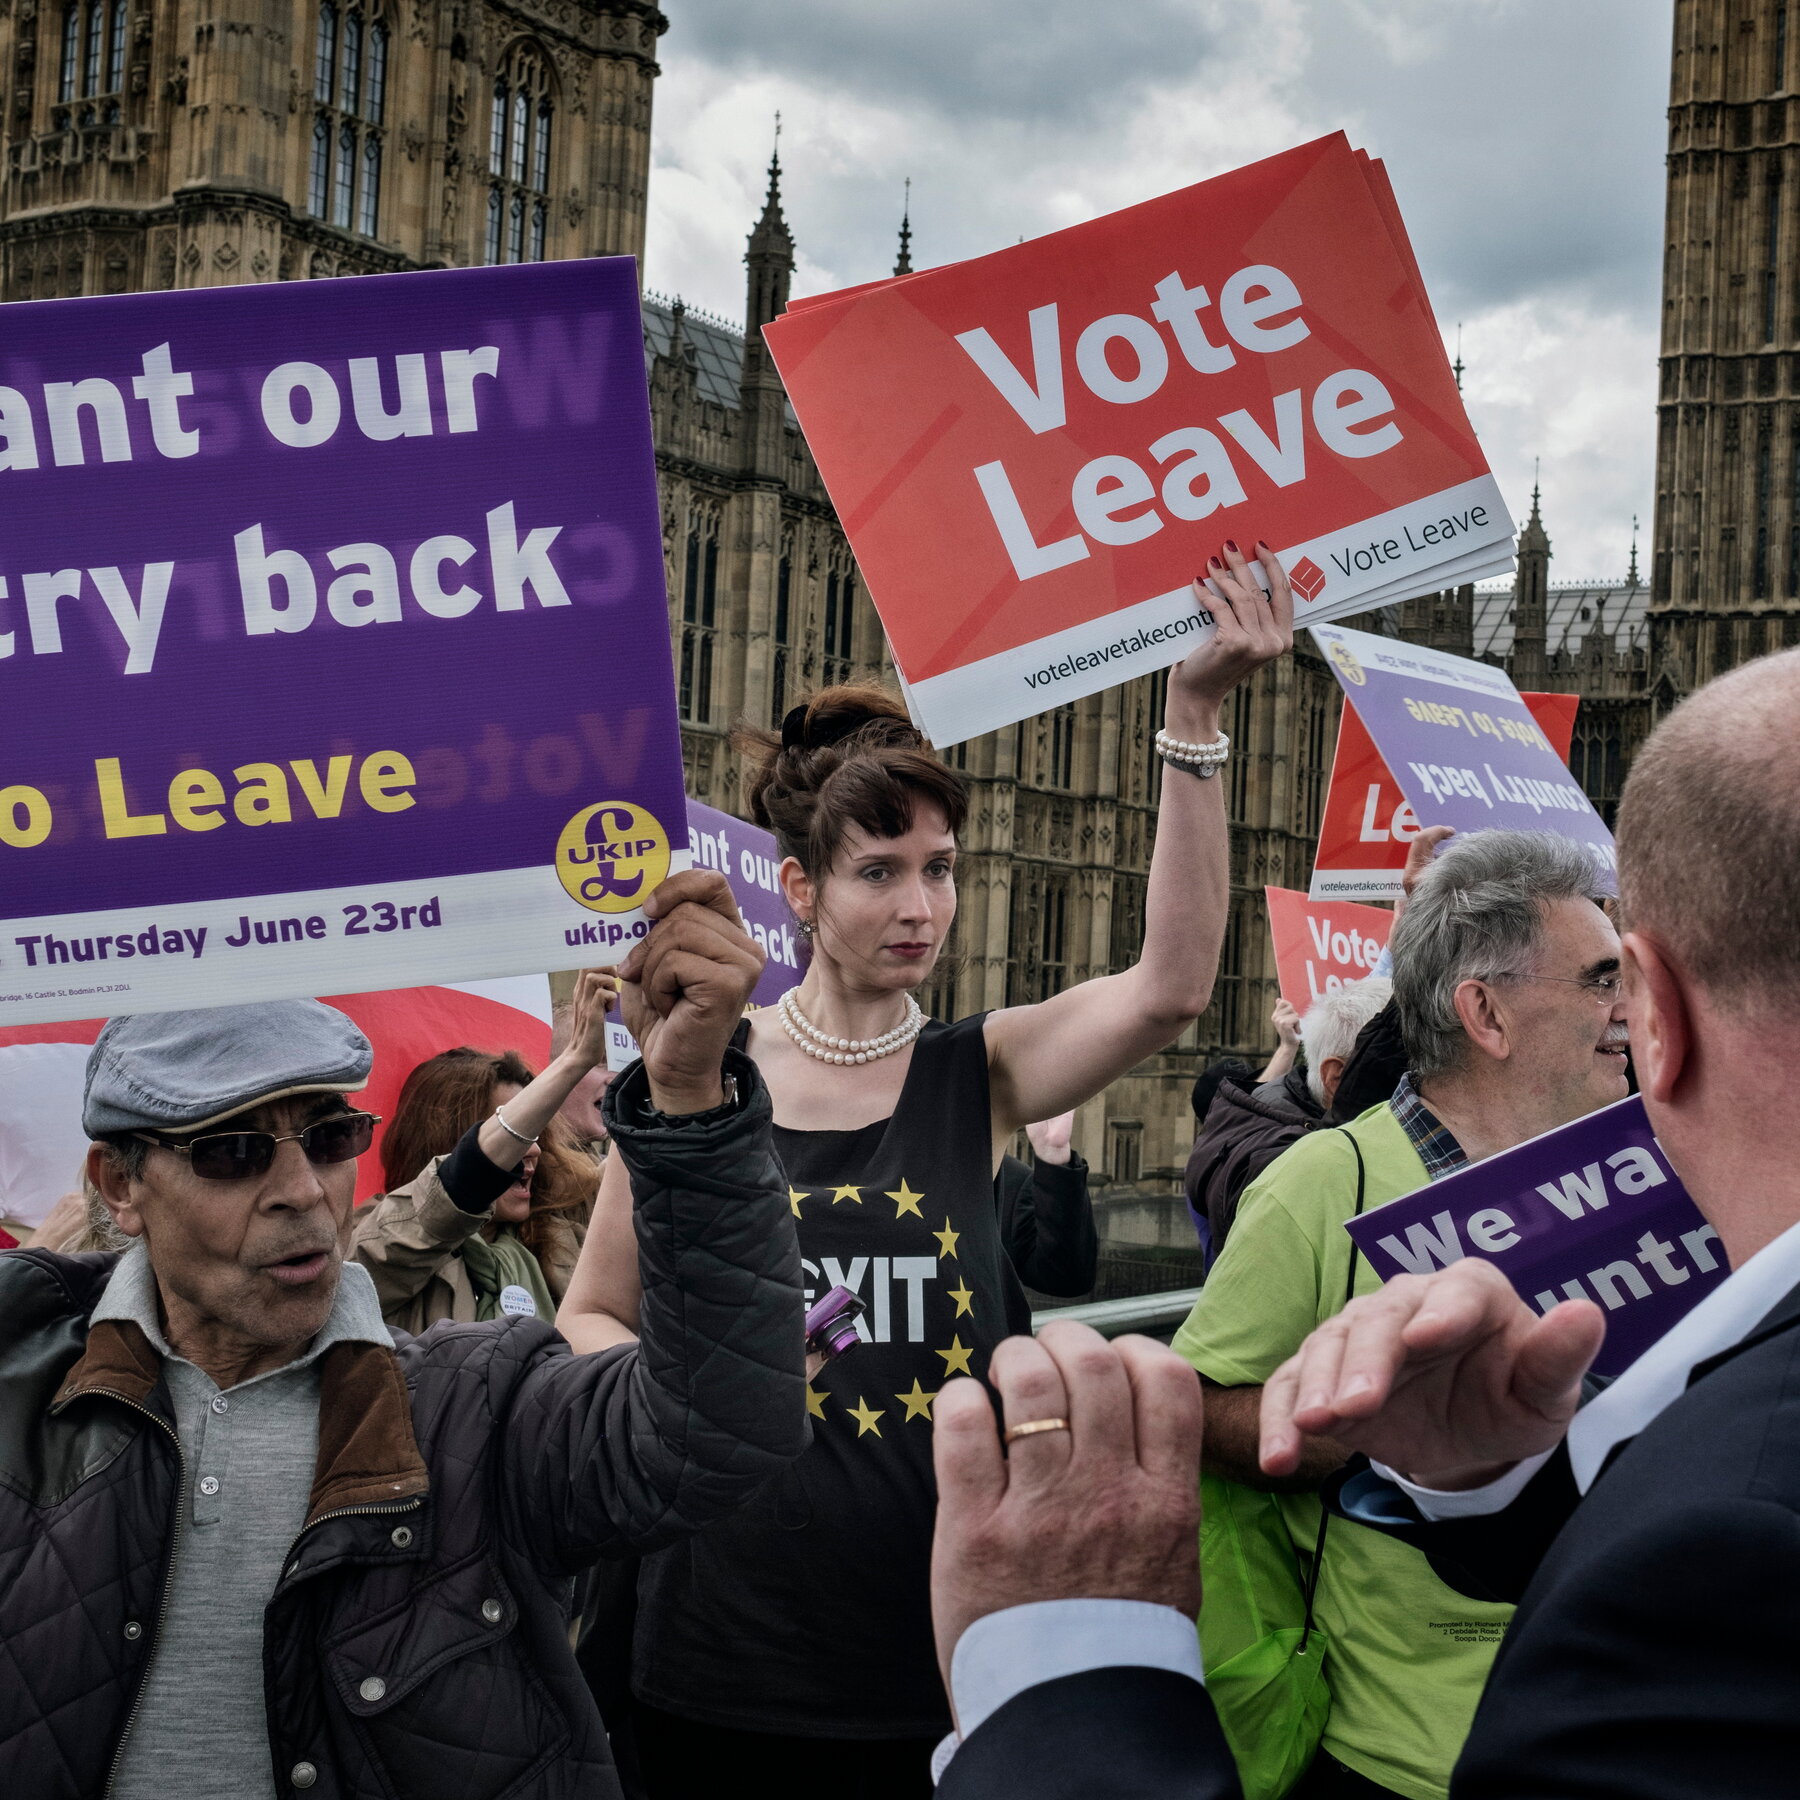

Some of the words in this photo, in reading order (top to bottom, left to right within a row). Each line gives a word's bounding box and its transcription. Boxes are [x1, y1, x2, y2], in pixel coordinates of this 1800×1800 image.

[954, 264, 1312, 435] Vote
[0, 341, 200, 471] ant
[260, 346, 500, 448] our
[973, 368, 1404, 582] Leave
[1330, 539, 1401, 577] Vote
[1403, 506, 1489, 552] Leave
[0, 561, 175, 675] ry
[233, 499, 572, 636] back
[1403, 697, 1479, 738] Leave
[1472, 711, 1505, 743] to
[94, 749, 418, 839] Leave
[1359, 783, 1422, 843] Le
[1407, 761, 1494, 810] back
[1483, 762, 1591, 816] country
[567, 838, 657, 865] UKIP
[687, 826, 731, 875] ant
[15, 924, 208, 967] Thursday
[224, 915, 327, 948] June
[341, 895, 442, 936] 23rd
[1306, 915, 1381, 970] Vote
[25, 992, 34, 1000] 16
[35, 990, 56, 999] Castle
[69, 987, 96, 996] Bodmin
[97, 985, 113, 993] PL31
[613, 1031, 629, 1049] EU
[1375, 1208, 1522, 1276] We
[1534, 1136, 1680, 1221] wa
